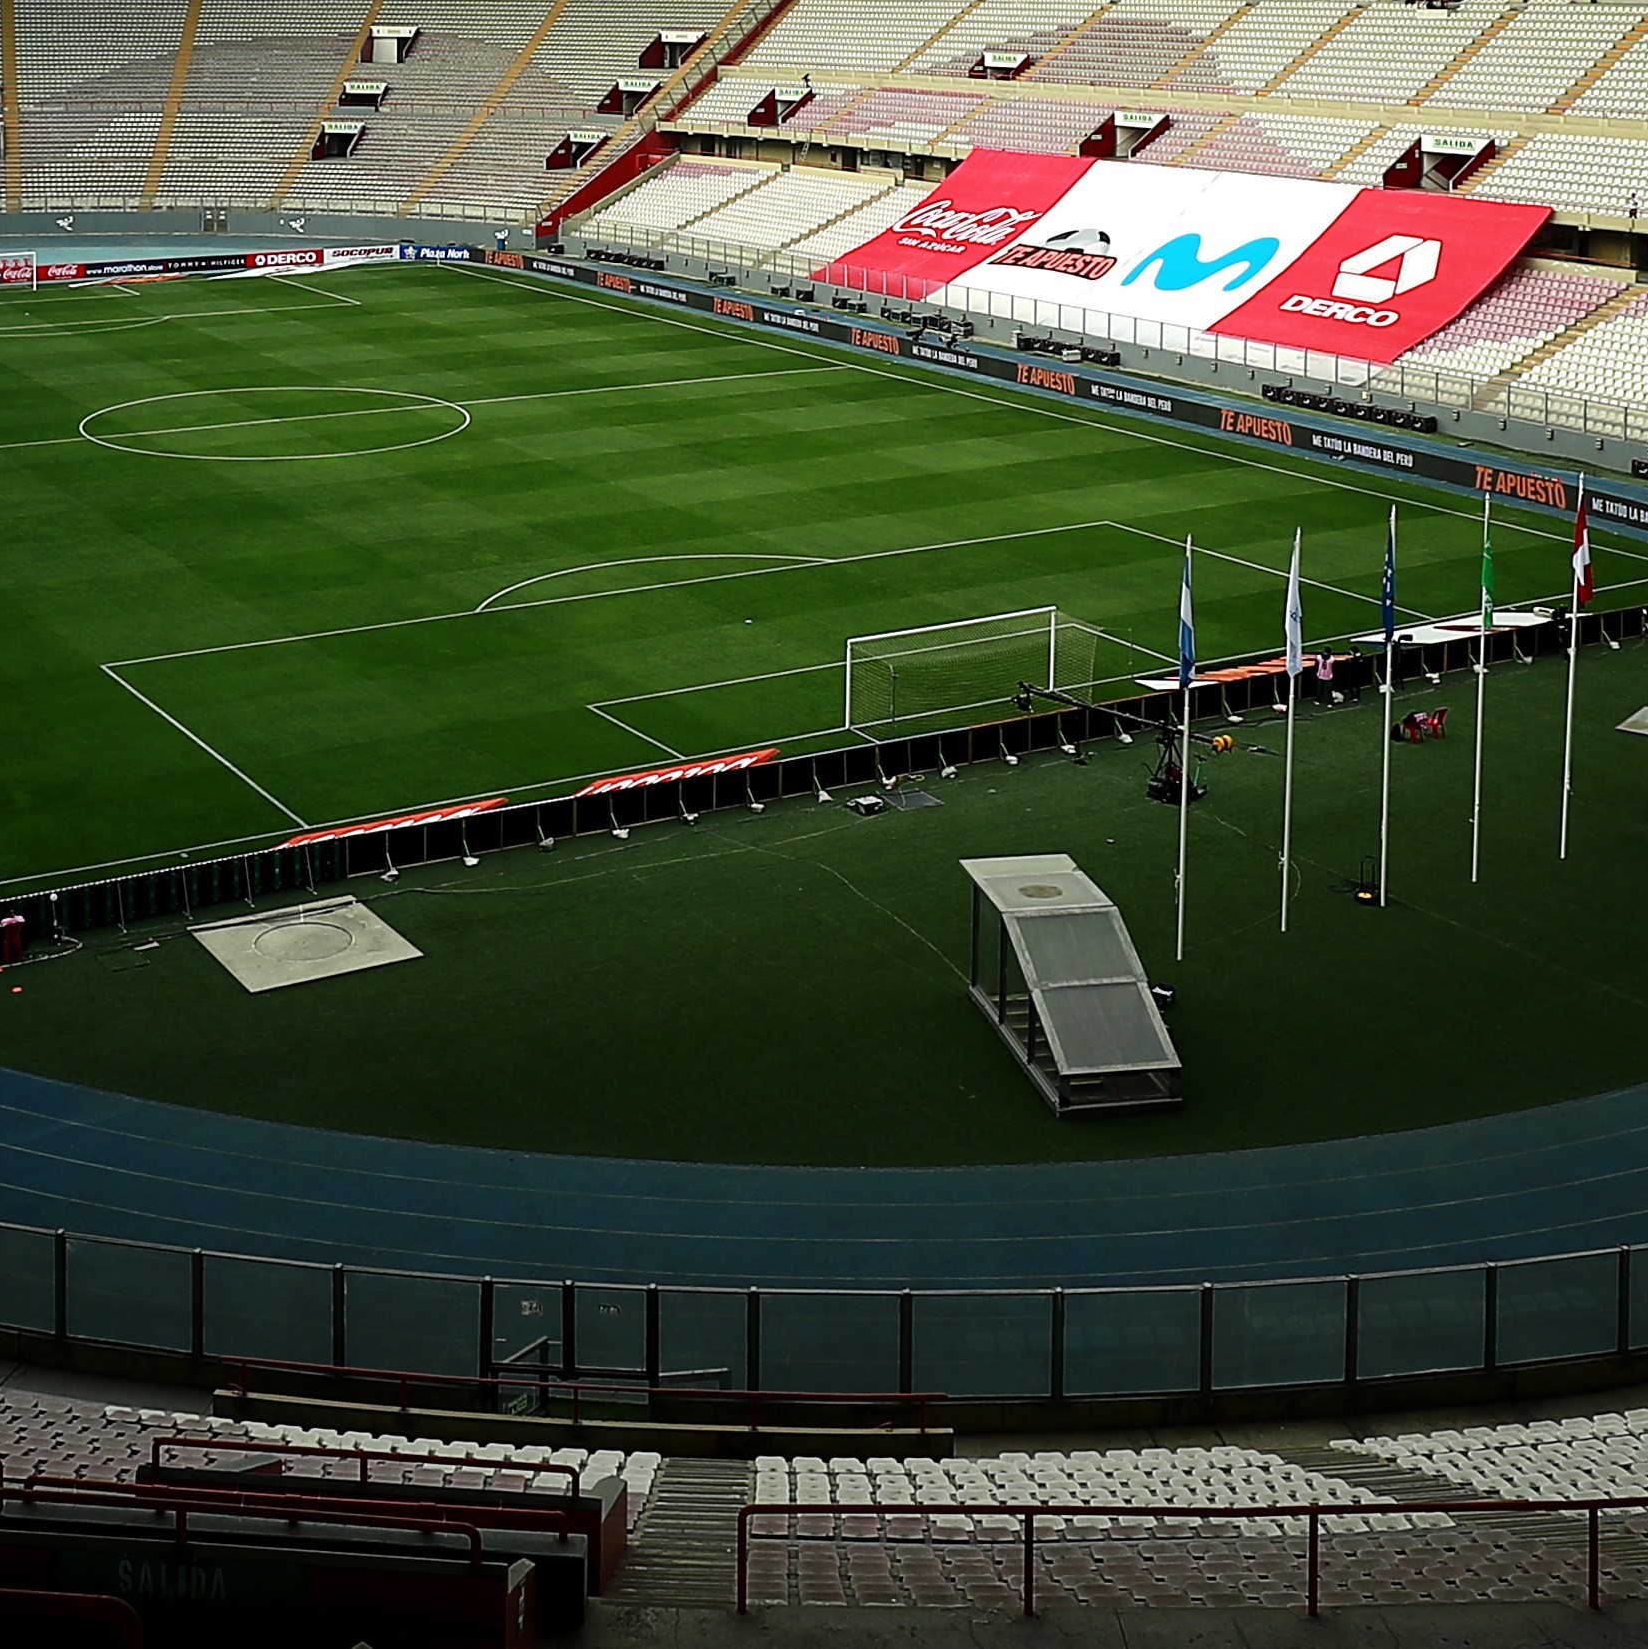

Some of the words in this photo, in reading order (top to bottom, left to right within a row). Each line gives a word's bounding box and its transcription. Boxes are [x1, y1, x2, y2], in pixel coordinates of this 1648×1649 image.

[1435, 138, 1474, 148] SALIDA
[267, 252, 316, 265] DERCO
[420, 248, 445, 258] Plaza
[447, 249, 470, 259] Nort
[993, 245, 1025, 264] TE
[1018, 249, 1115, 278] APUESTO
[722, 299, 753, 321] APUESTO
[1279, 294, 1399, 327] DERCO
[851, 327, 861, 345] TE
[862, 330, 899, 355] APUESTO
[1017, 363, 1029, 383] TE
[1029, 366, 1076, 396] APUESTO
[1221, 408, 1234, 431] TE
[1236, 413, 1292, 445] APUESTO
[1312, 434, 1322, 447] ME
[1343, 440, 1352, 453] LA
[1353, 442, 1381, 461] BANDERA
[1382, 449, 1395, 463] DEL
[1396, 451, 1413, 468] PERÚ
[1475, 466, 1492, 492] TE
[1495, 472, 1566, 509] APUESTO
[1592, 498, 1604, 512] ME
[1629, 506, 1639, 521] LA
[119, 1559, 227, 1600] SALIDA
